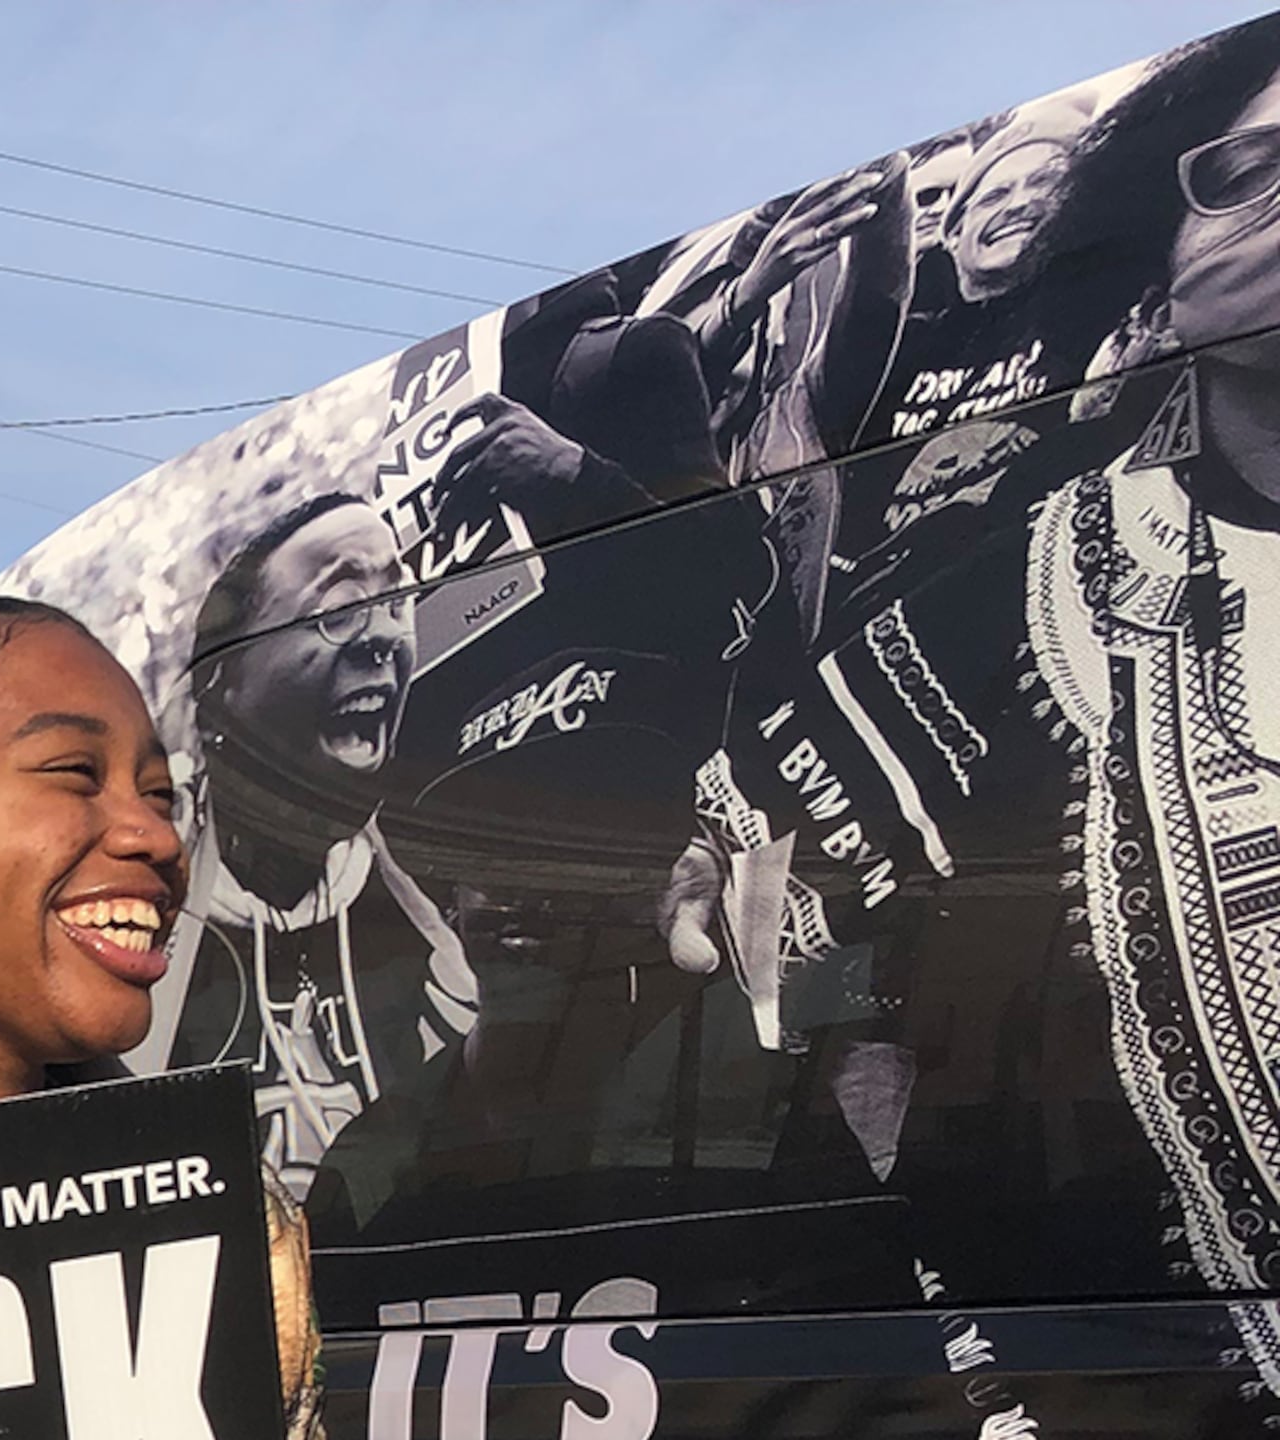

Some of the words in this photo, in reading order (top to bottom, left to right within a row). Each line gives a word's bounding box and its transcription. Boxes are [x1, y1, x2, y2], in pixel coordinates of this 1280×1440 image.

[463, 580, 519, 626] NAACP
[778, 737, 851, 822] BVM
[820, 820, 898, 910] BVM
[1, 1155, 226, 1228] MATTER.
